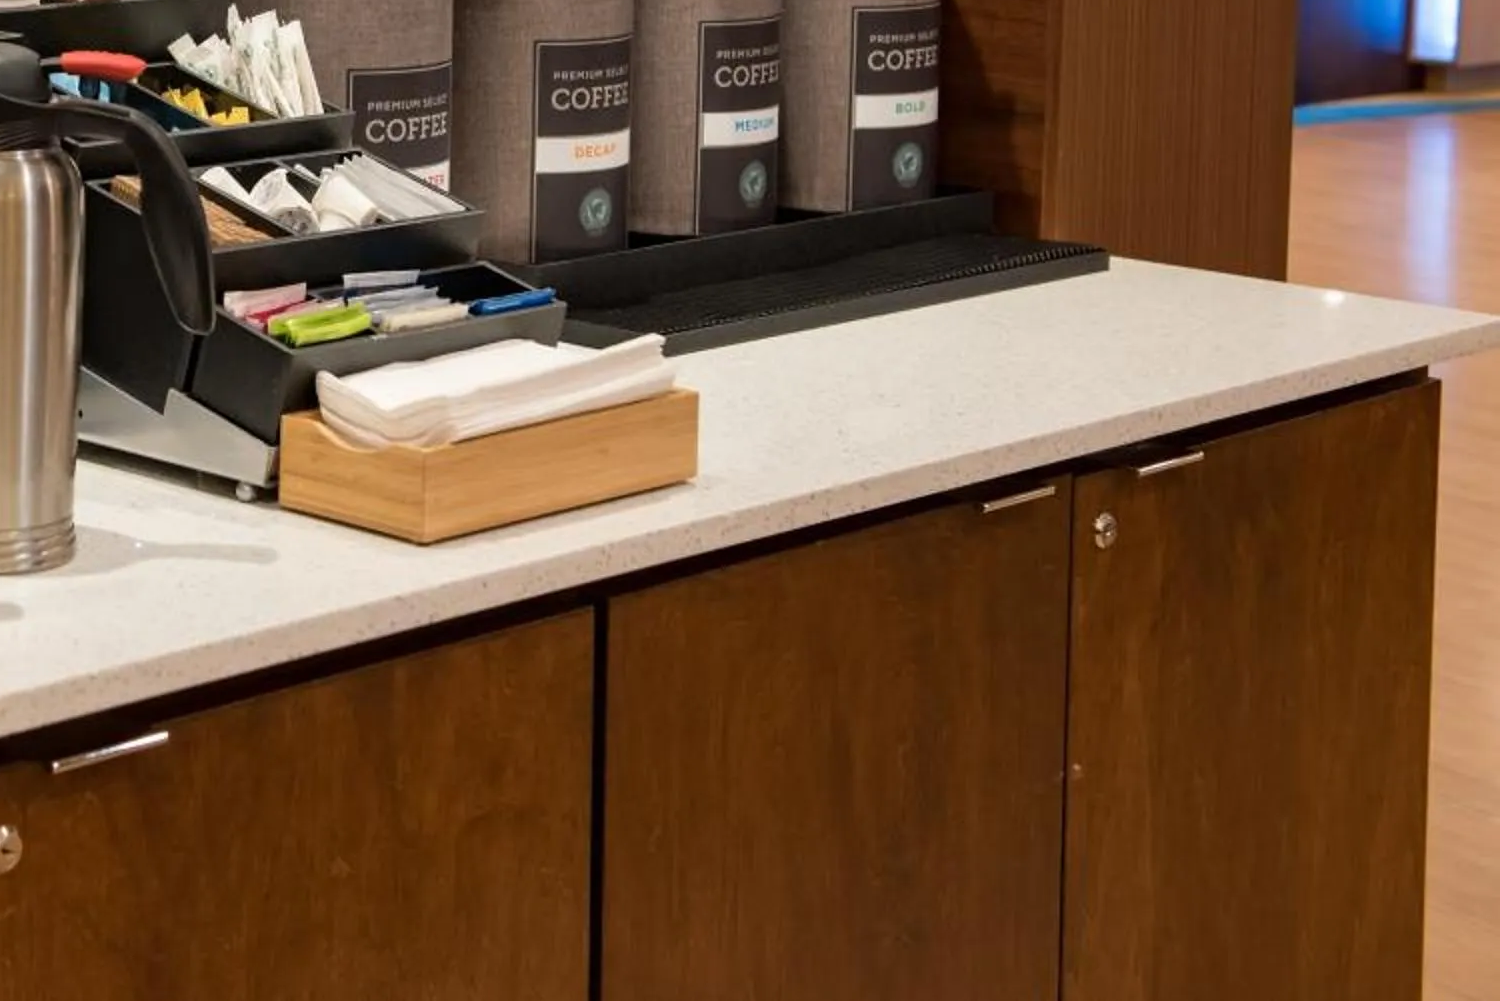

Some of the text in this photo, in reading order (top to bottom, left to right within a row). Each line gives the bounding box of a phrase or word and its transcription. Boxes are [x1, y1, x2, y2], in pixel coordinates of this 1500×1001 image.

[868, 32, 917, 45] PREMIUM
[553, 69, 603, 81] PREMIUM
[367, 99, 421, 112] PREMIUM
[895, 100, 926, 115] BOLD
[734, 115, 775, 134] MEDIUM
[573, 141, 618, 160] DECAF
